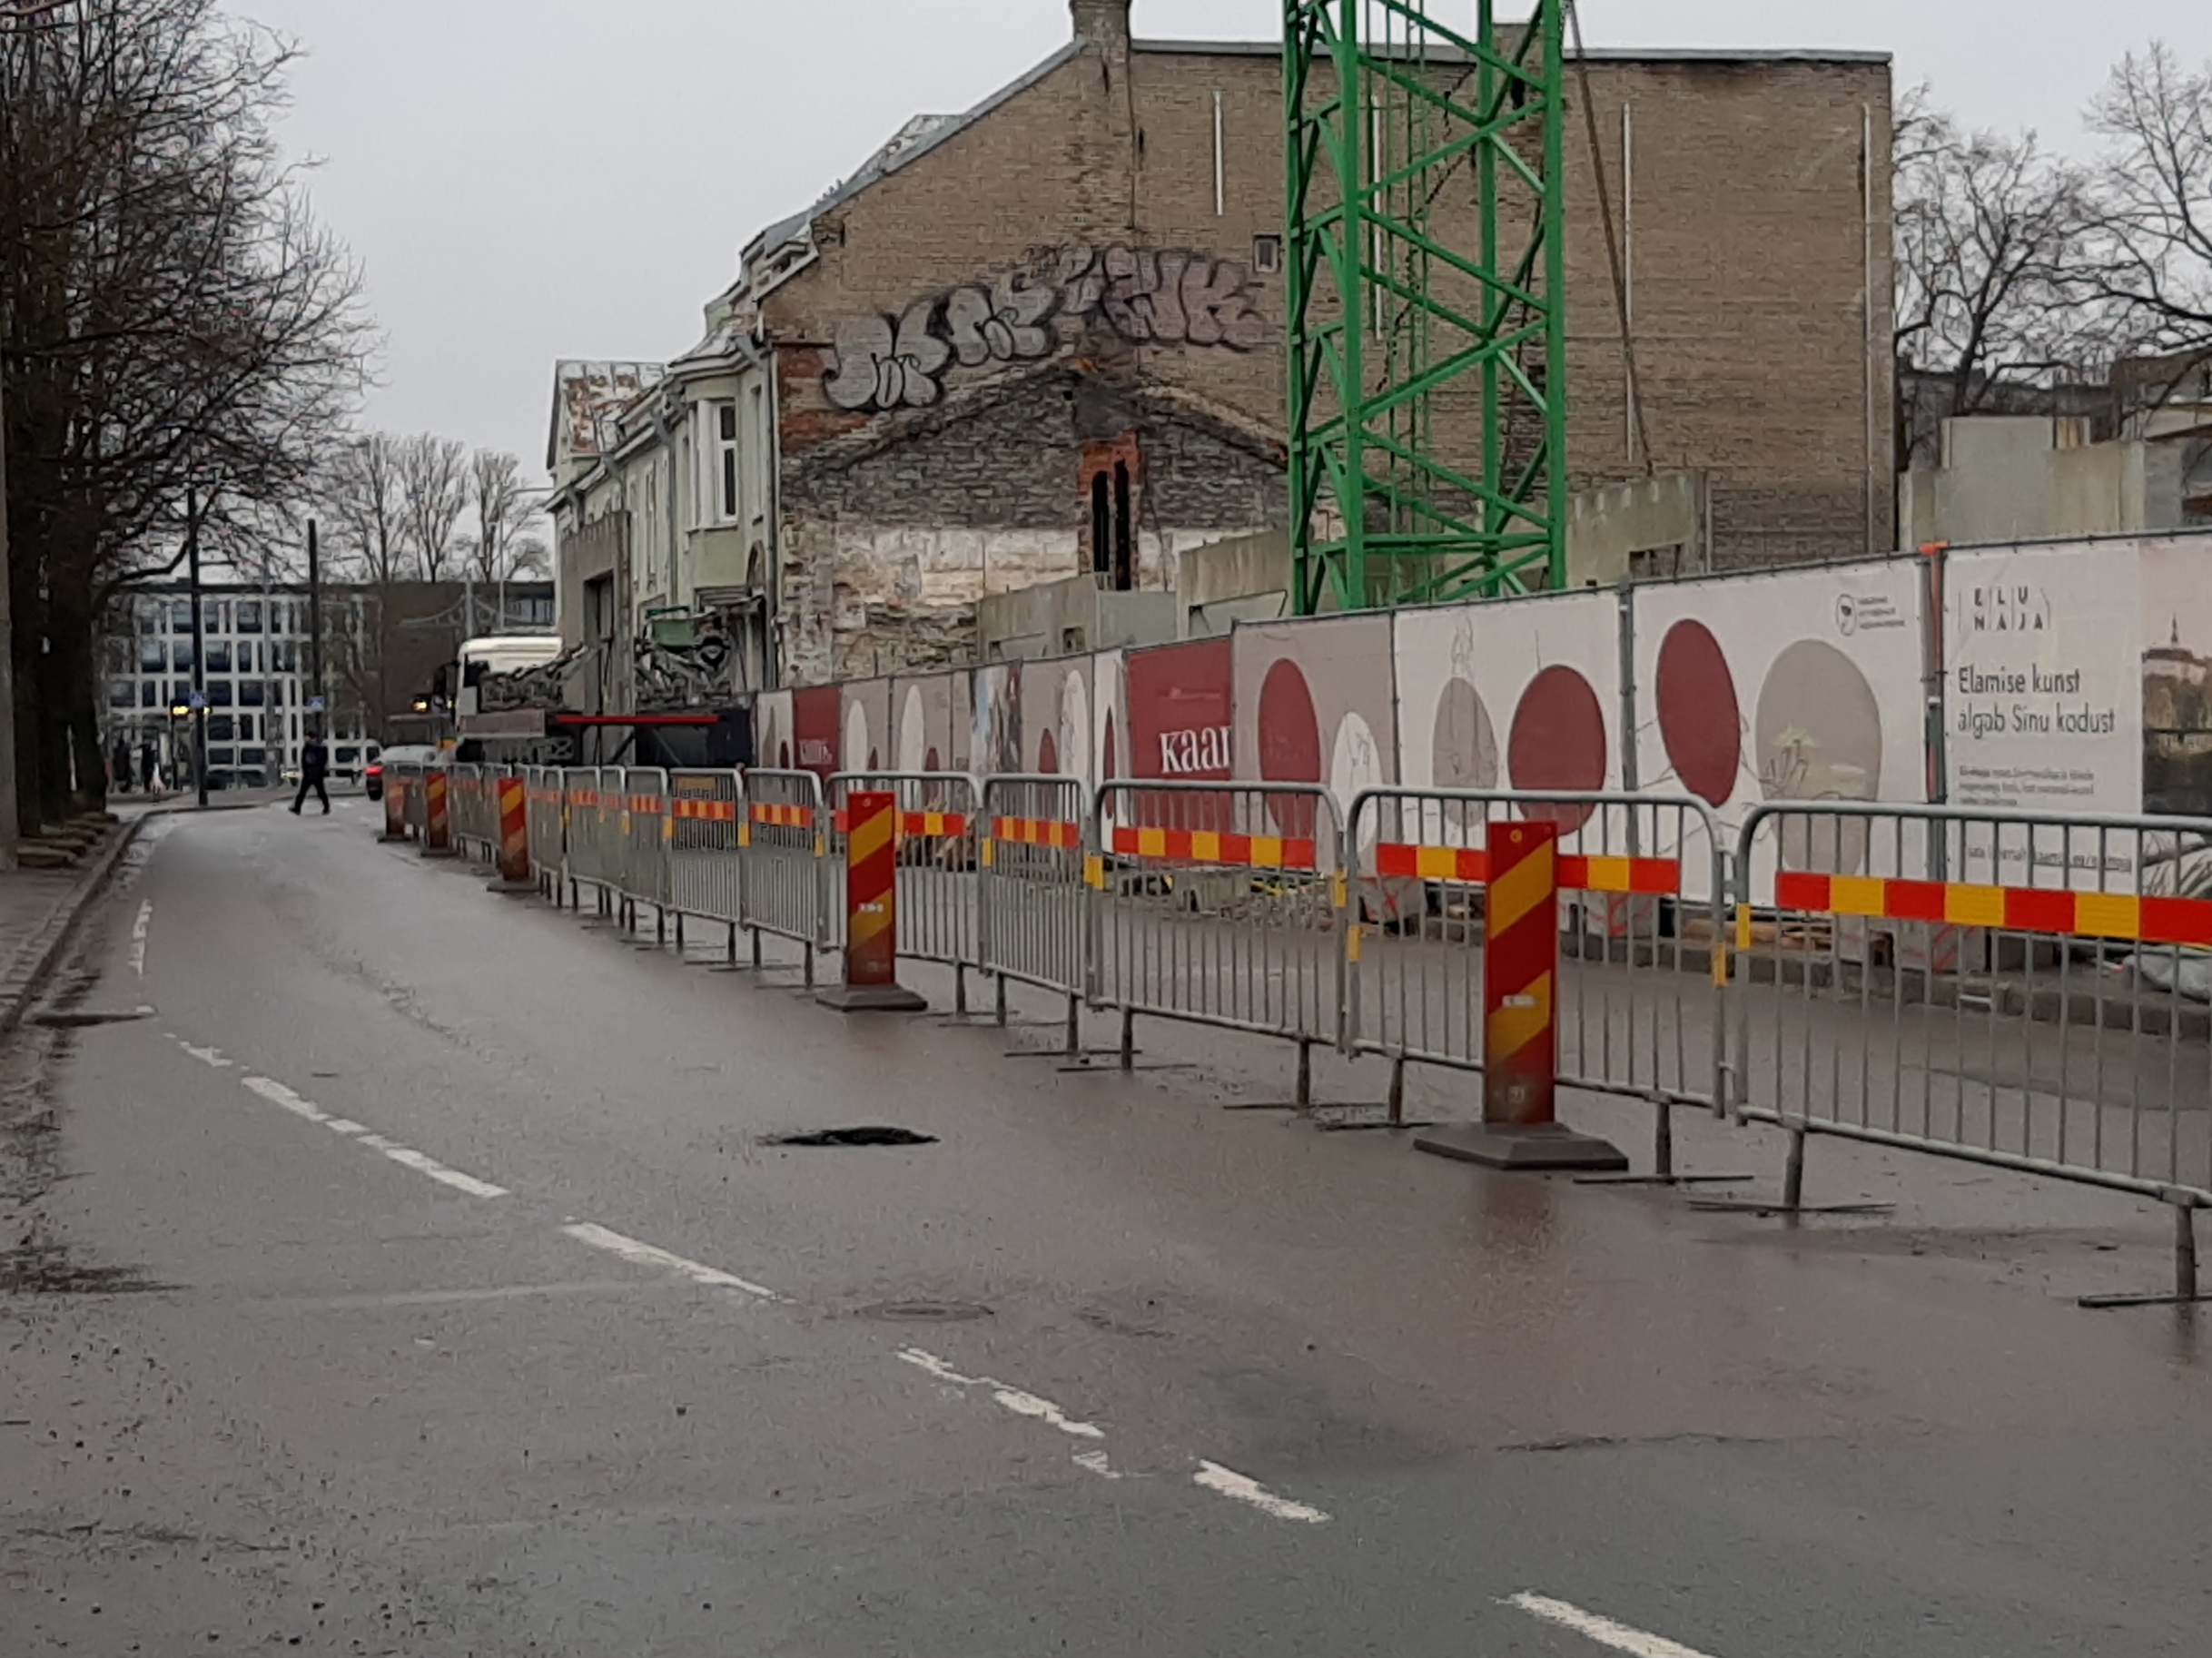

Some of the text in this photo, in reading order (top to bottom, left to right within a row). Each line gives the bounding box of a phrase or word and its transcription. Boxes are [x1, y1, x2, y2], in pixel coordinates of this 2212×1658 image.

[1973, 613, 2043, 631] NAJA
[1958, 663, 2080, 694] Elamise kunst
[1958, 702, 2115, 740] algab Sinu kodust
